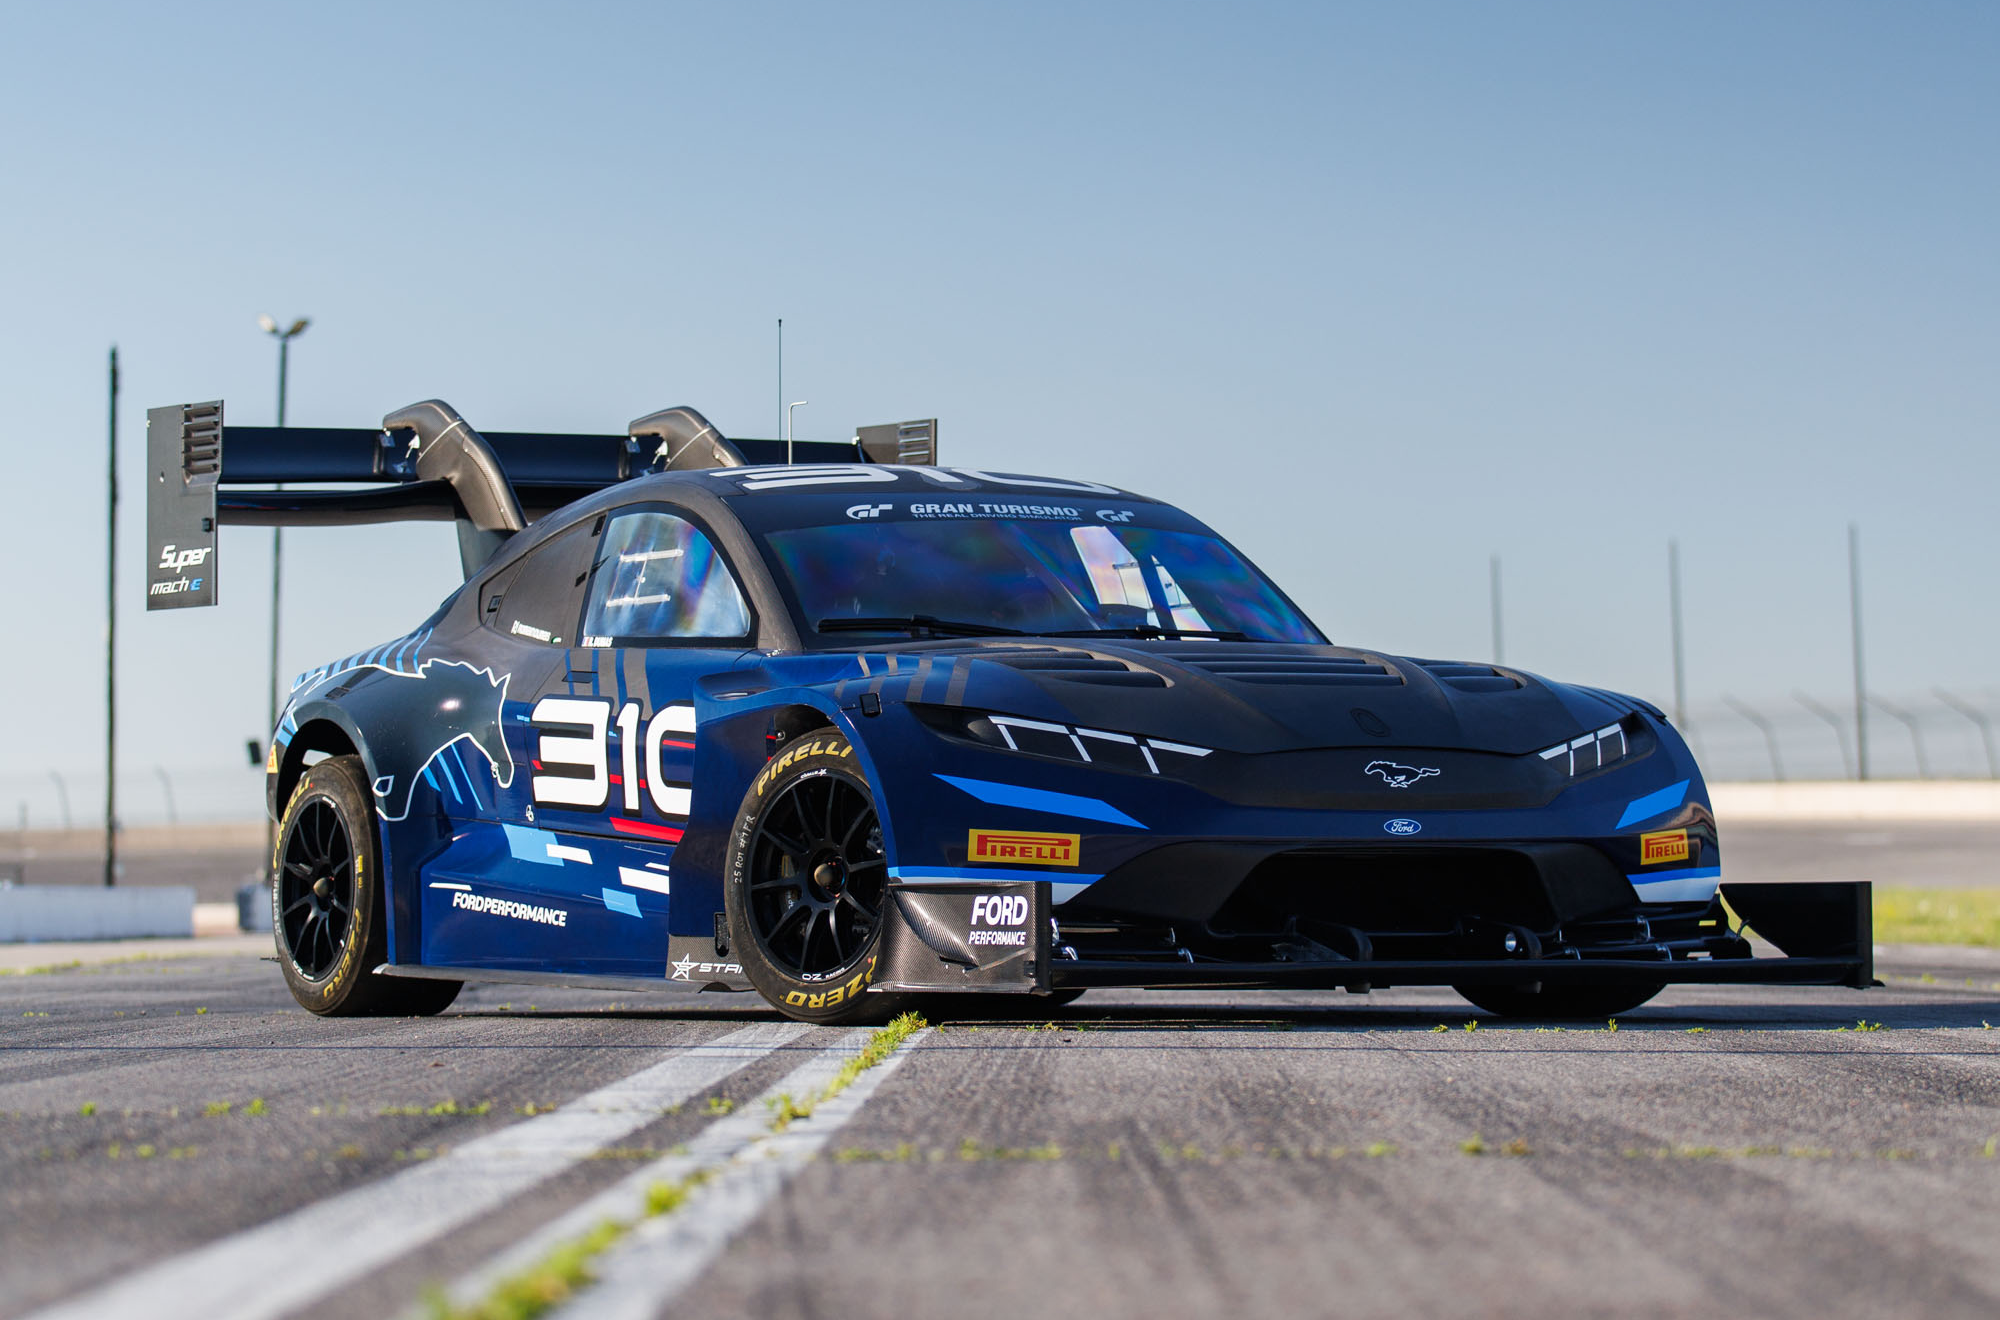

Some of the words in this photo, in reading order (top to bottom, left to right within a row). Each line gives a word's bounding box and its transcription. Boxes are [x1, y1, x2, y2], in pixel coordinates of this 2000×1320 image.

[910, 503, 974, 514] GRAN
[979, 504, 1079, 517] TURISMO
[159, 545, 212, 573] Super
[757, 741, 853, 796] PIRELLI
[743, 815, 756, 832] FR
[1391, 821, 1415, 832] Ford
[976, 834, 1072, 860] PIRELLI
[1645, 834, 1685, 859] PIRELLI
[971, 896, 1028, 925] FORD
[969, 931, 1026, 945] PERFORMANCE
